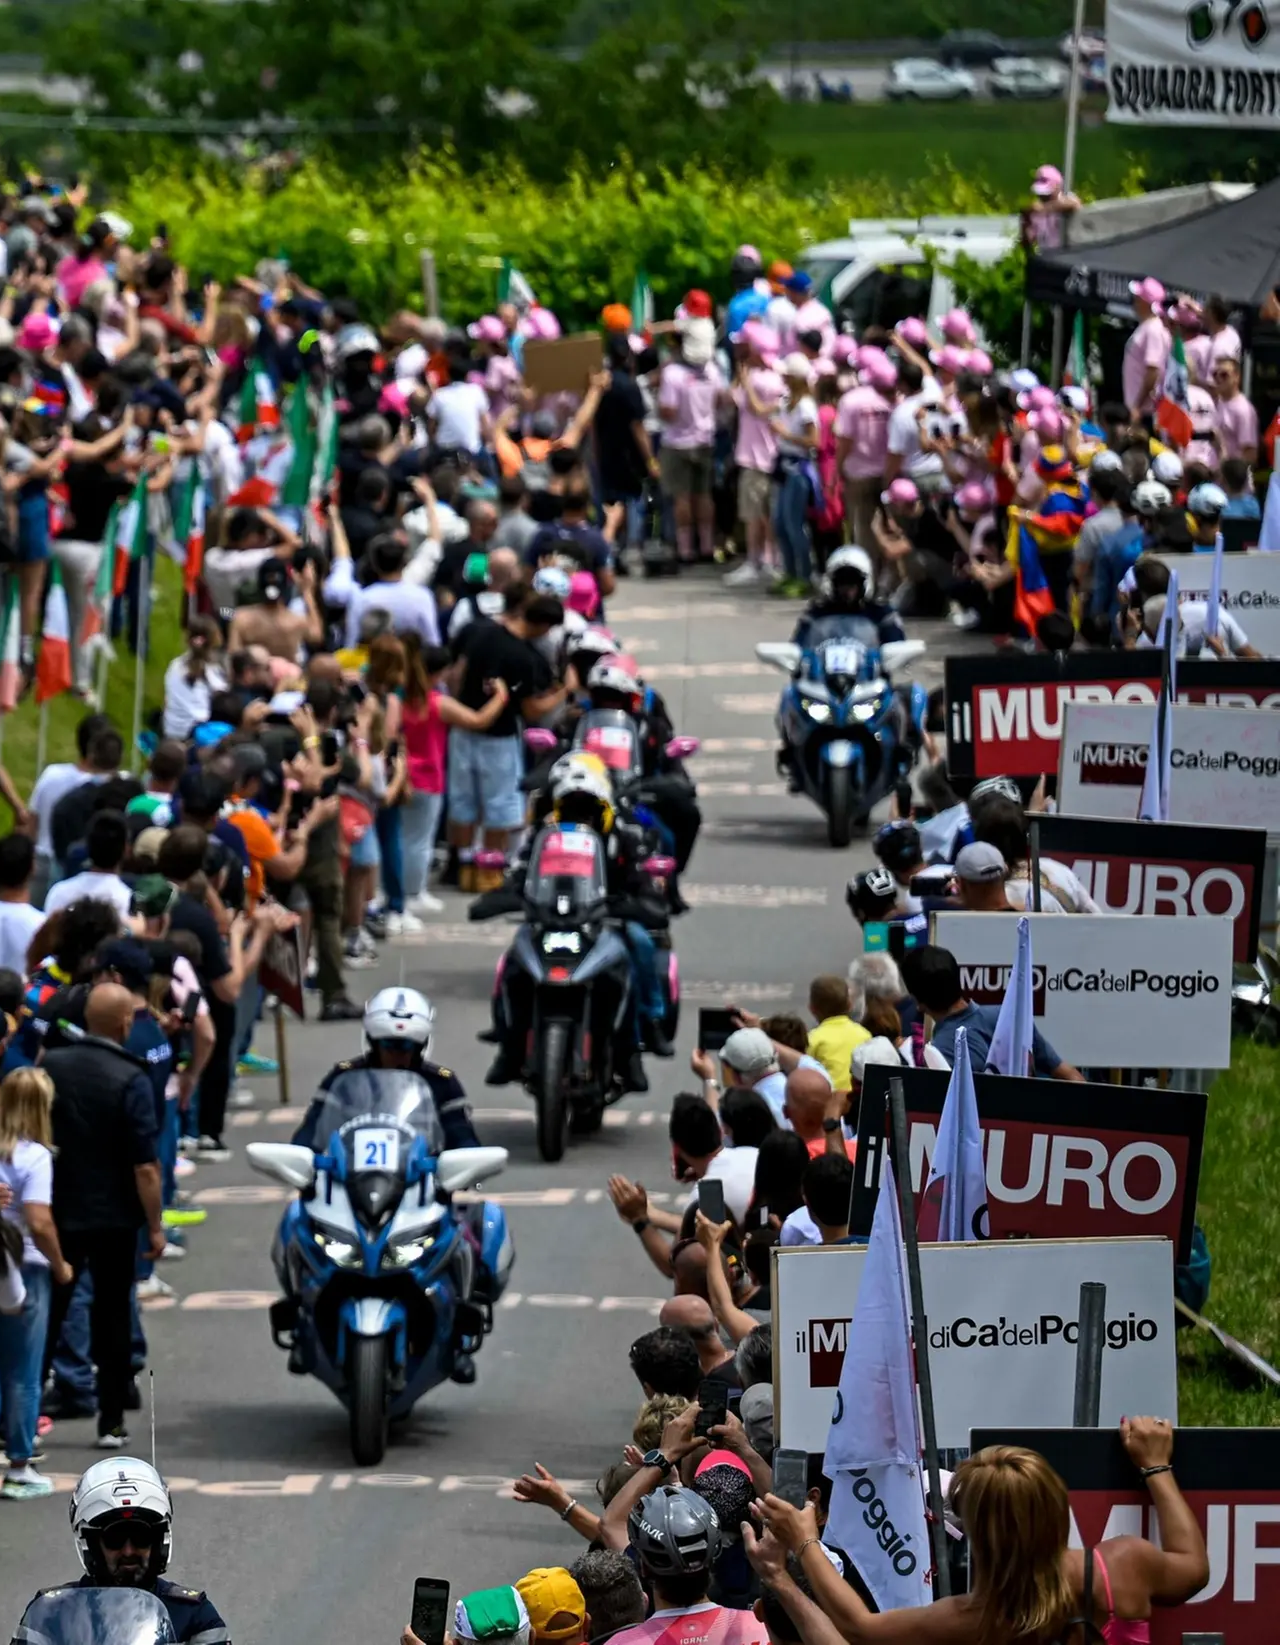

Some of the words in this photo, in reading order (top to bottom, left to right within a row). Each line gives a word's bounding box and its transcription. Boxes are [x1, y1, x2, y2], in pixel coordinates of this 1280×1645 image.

[1111, 62, 1216, 116] SQUADRA
[952, 701, 972, 744] il
[365, 1141, 386, 1165] 21
[796, 1331, 805, 1352] il
[847, 1468, 917, 1577] oggio
